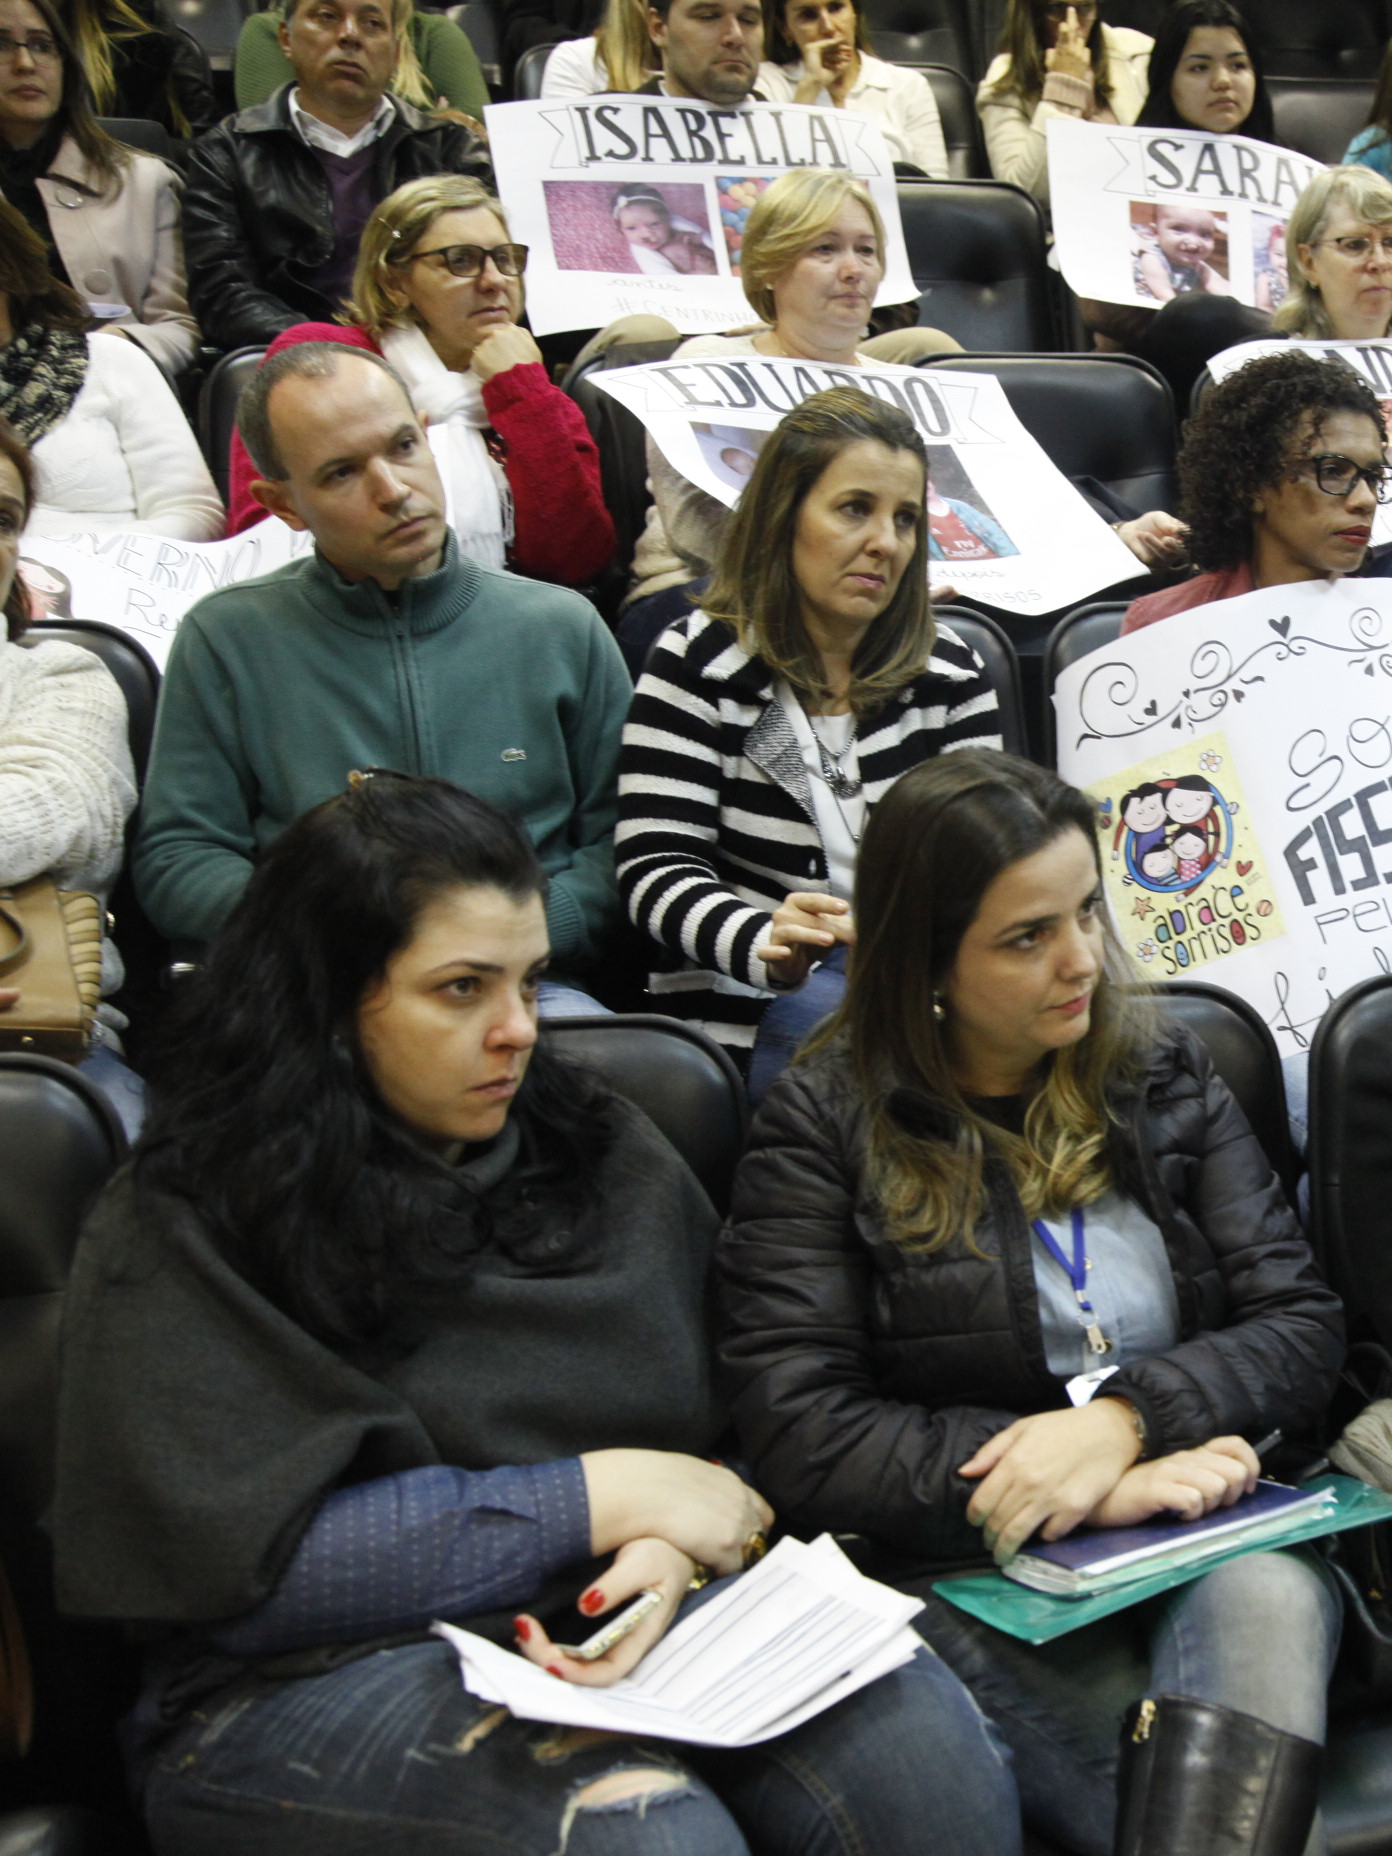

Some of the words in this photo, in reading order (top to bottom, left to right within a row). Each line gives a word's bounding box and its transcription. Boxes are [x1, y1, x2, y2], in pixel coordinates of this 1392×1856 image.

[573, 104, 847, 168] ISABELLA
[1147, 138, 1313, 206] SARA
[1153, 884, 1249, 944] abrace
[1160, 912, 1262, 976] sorrisos
